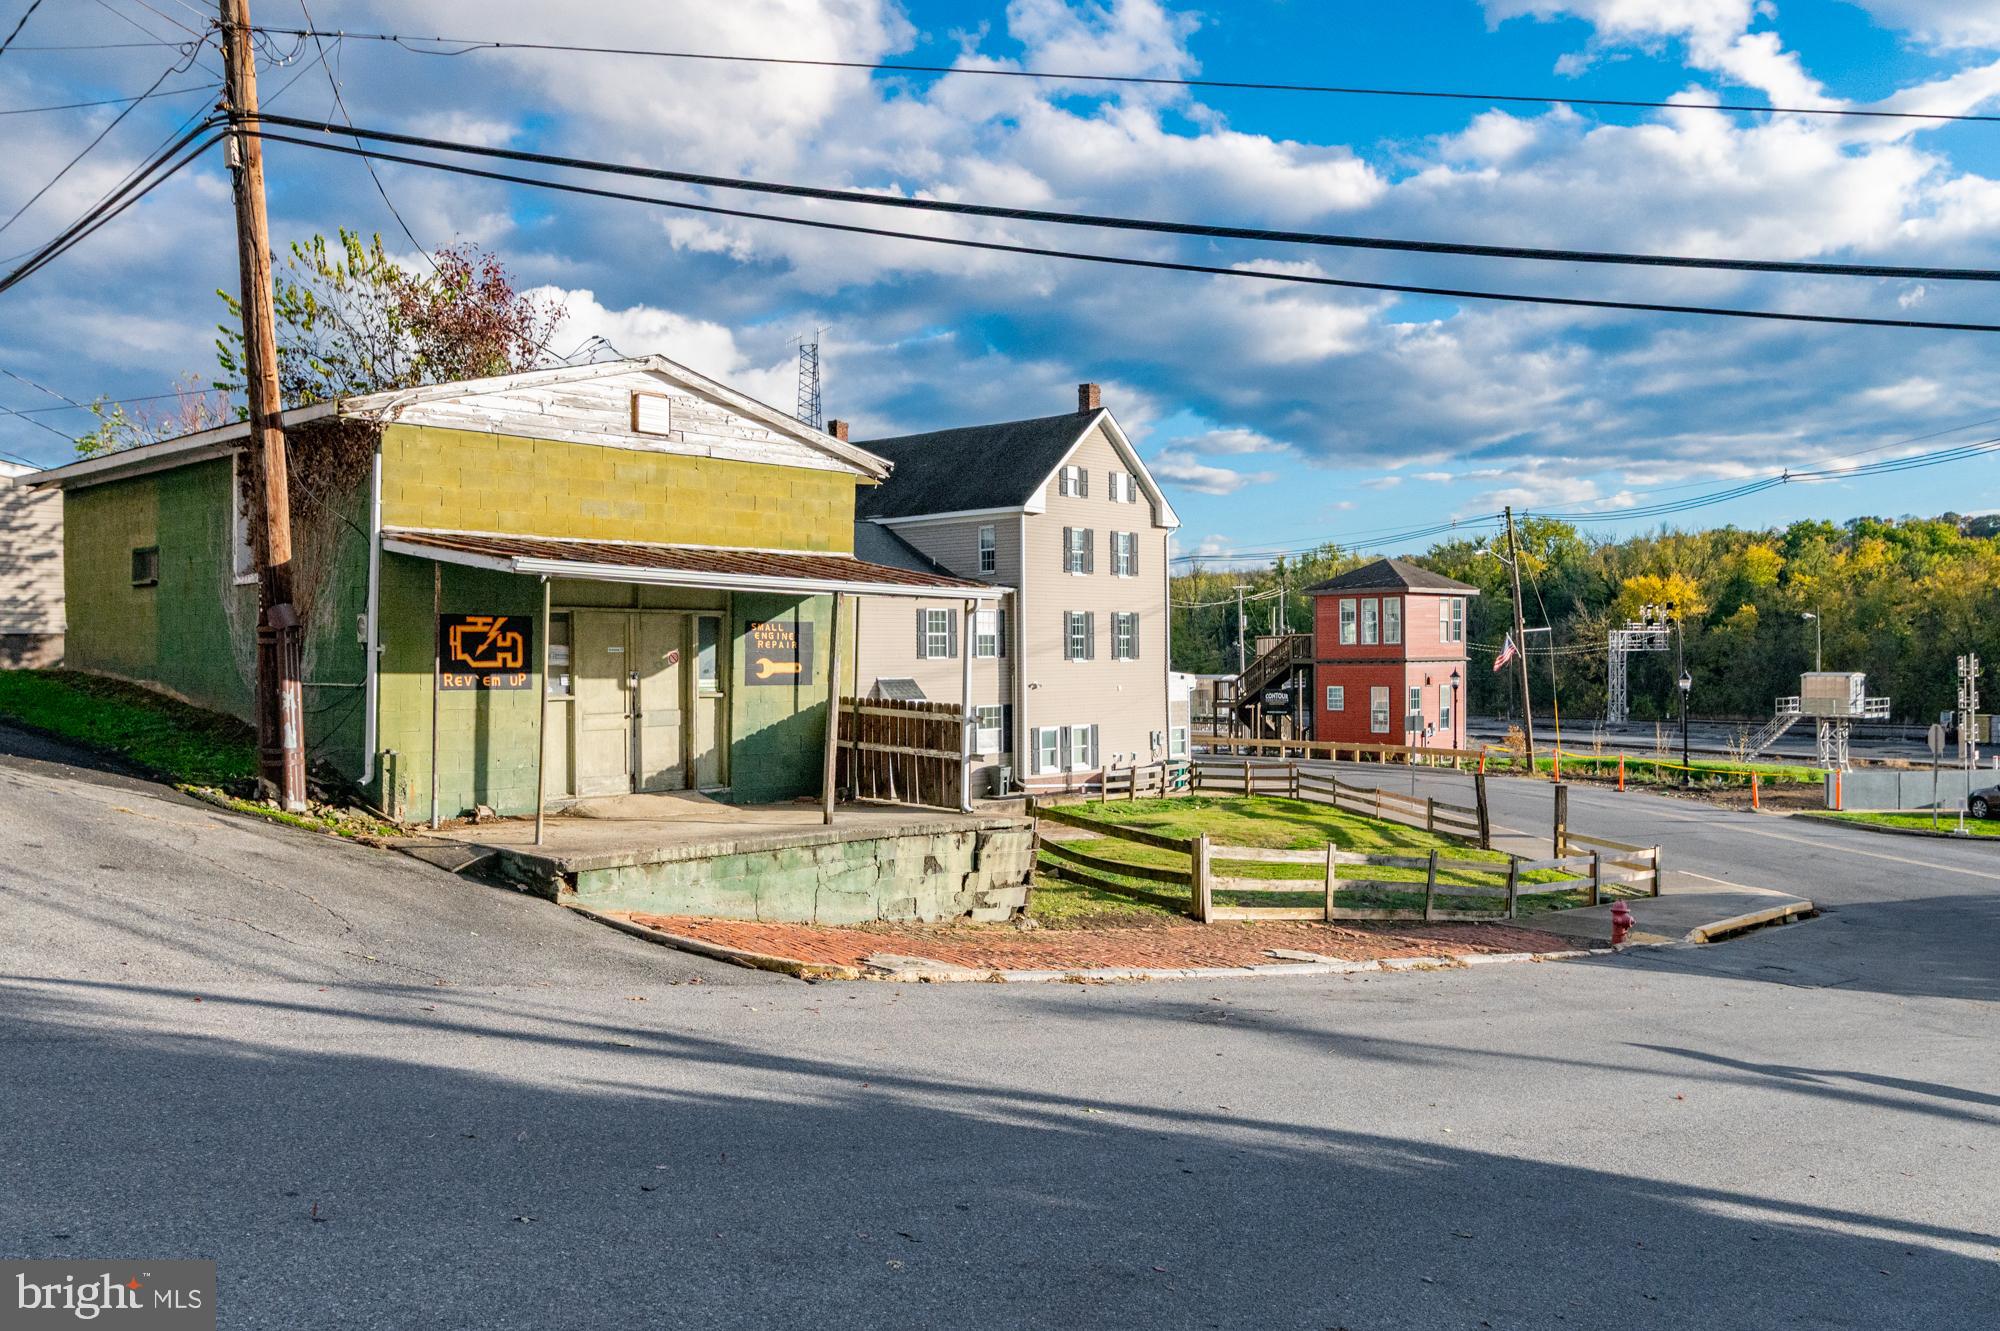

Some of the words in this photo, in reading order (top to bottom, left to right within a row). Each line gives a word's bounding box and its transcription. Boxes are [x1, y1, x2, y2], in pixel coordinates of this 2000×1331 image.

[751, 622, 784, 631] SMALL
[754, 632, 795, 640] ENGINE
[757, 641, 797, 649] REPAIR
[1265, 692, 1289, 700] CONTOUR
